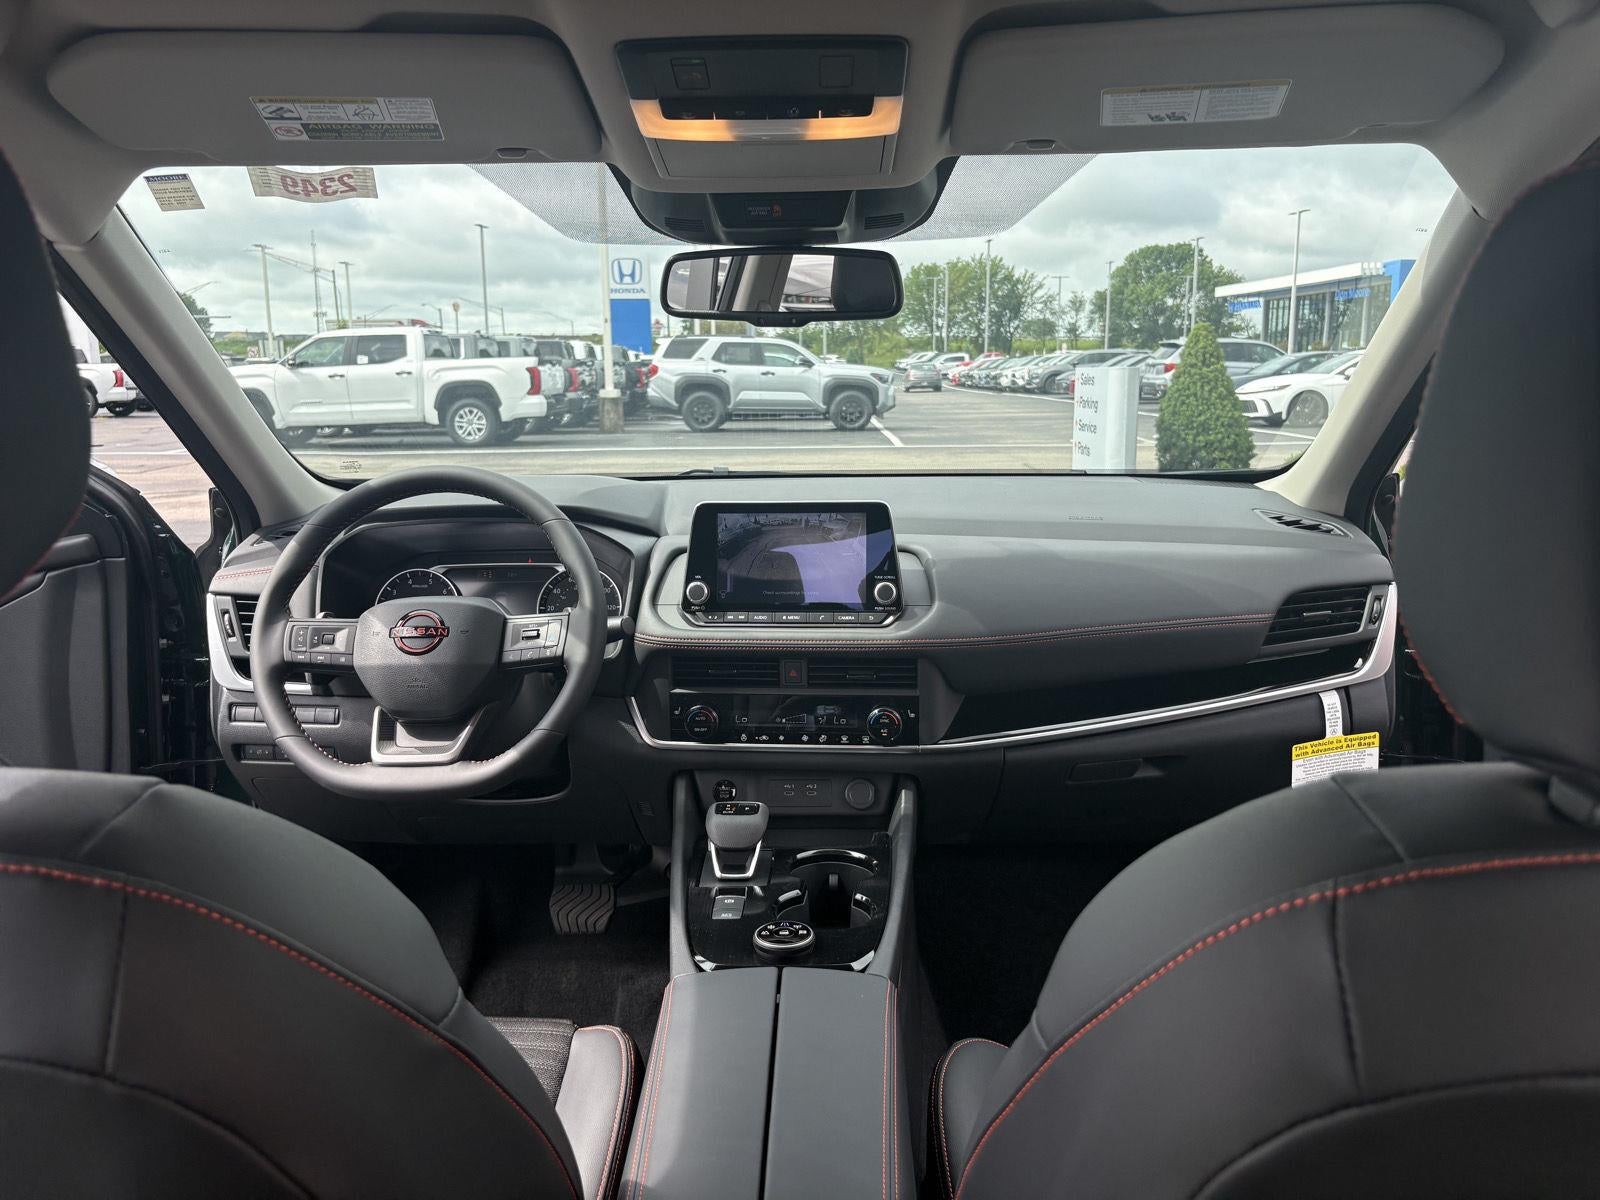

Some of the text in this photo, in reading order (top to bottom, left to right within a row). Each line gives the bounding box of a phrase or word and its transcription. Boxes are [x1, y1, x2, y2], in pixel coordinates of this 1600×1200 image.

[1080, 373, 1095, 386] Sales
[1079, 396, 1099, 414] Parking
[1077, 419, 1097, 434] Service
[1077, 441, 1091, 457] Parts
[393, 627, 448, 636] NISSAN
[1310, 740, 1334, 748] Vehicle
[1344, 734, 1377, 743] Equipped
[1310, 745, 1344, 755] Advanced
